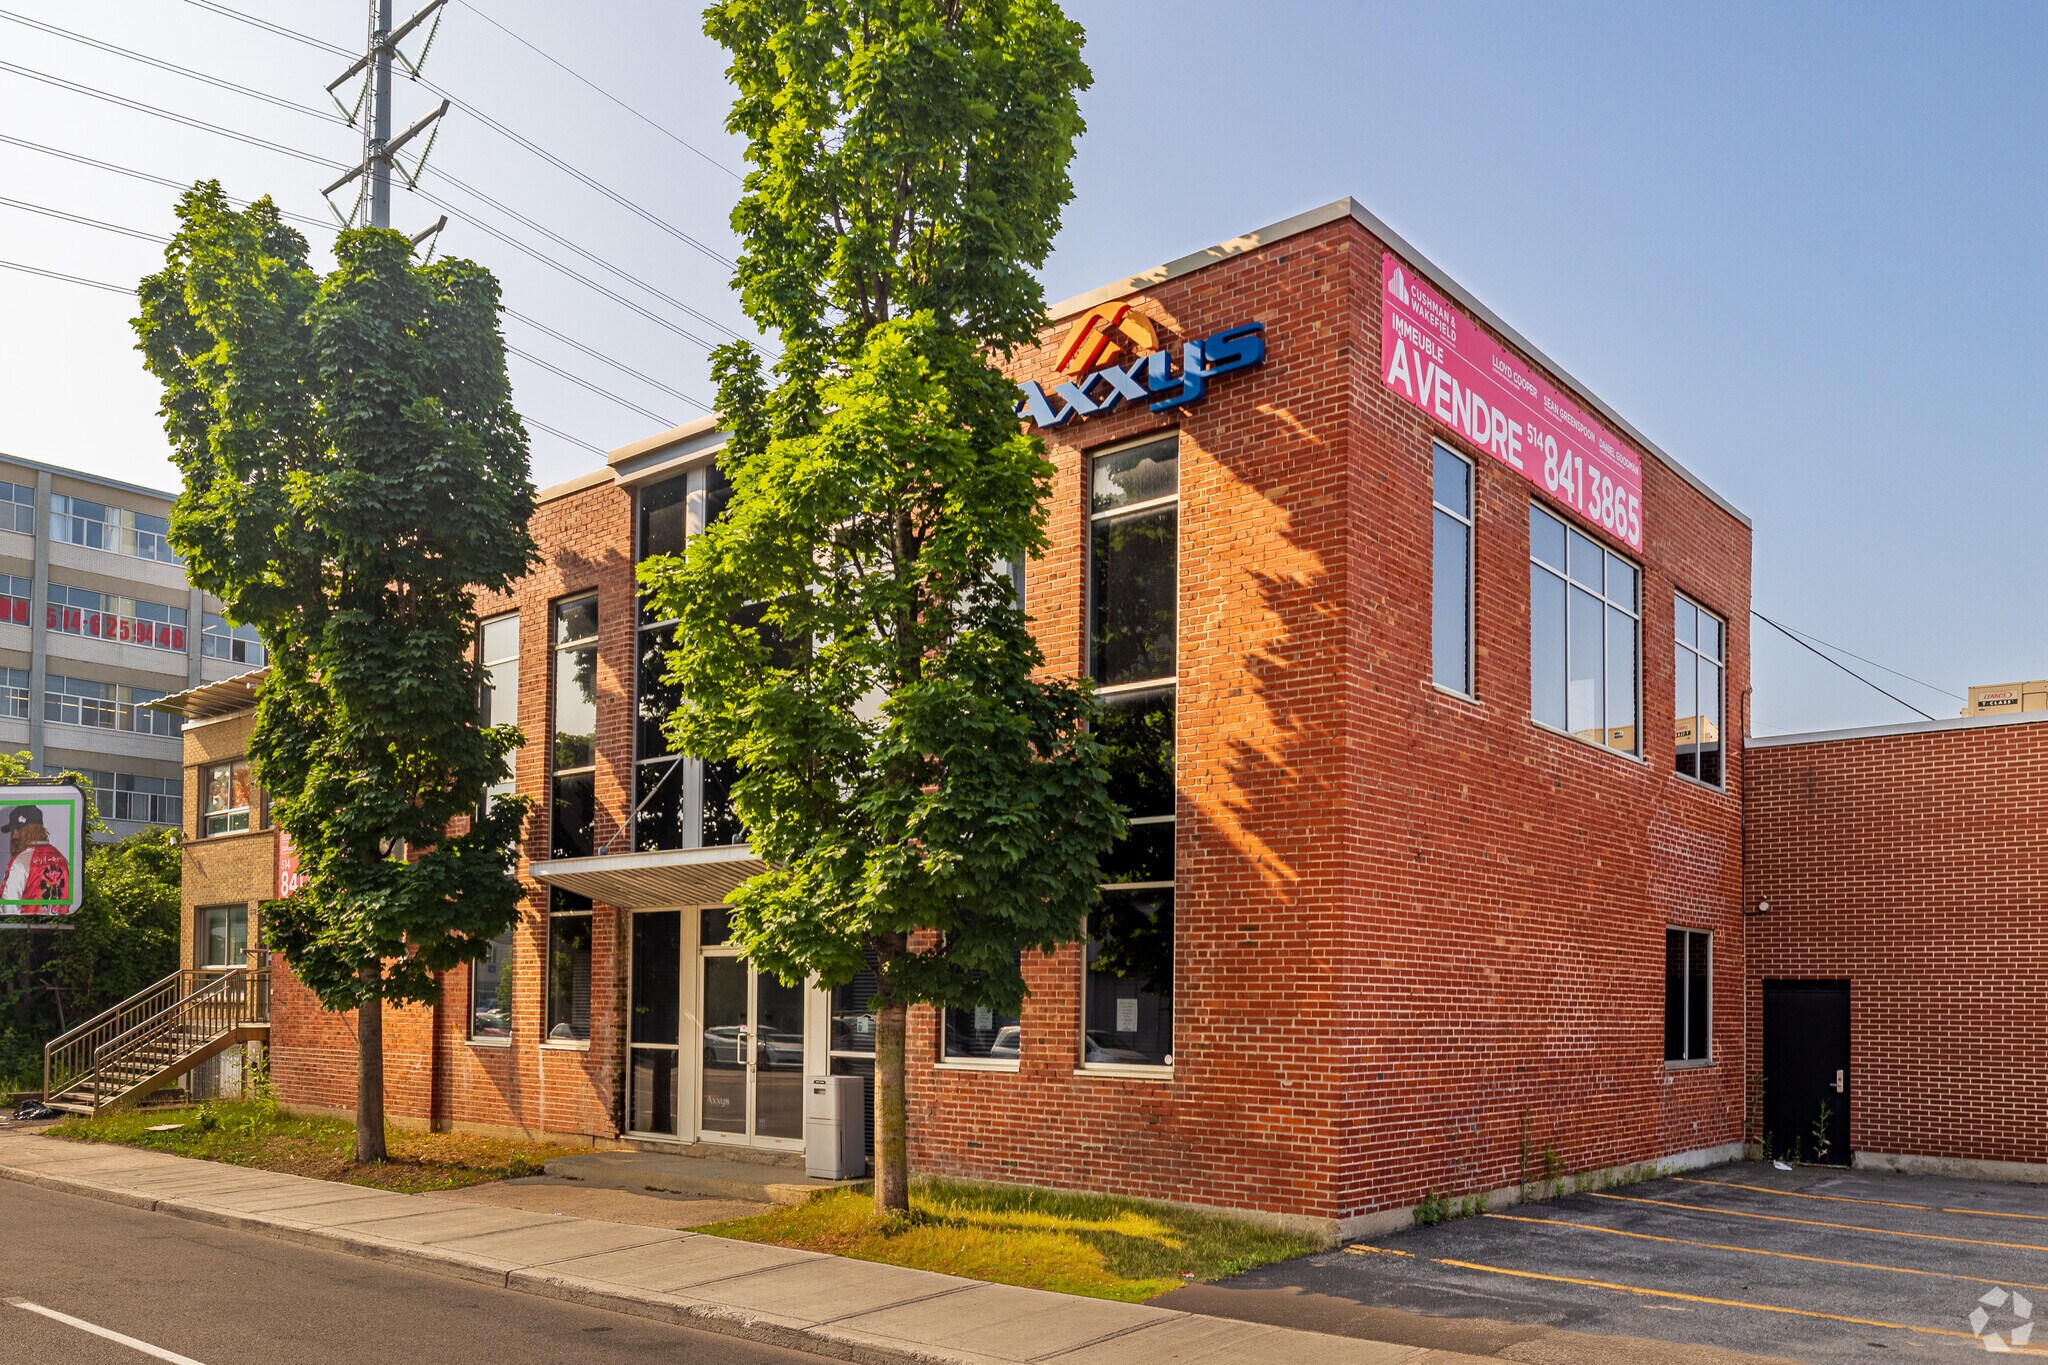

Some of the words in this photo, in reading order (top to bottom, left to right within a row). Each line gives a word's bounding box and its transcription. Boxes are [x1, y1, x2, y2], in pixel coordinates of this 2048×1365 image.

[1411, 285, 1450, 323] CUSHMAN
[1450, 316, 1457, 329] &
[1411, 298, 1457, 342] WAKEFIELD
[1391, 312, 1444, 365] IMMEUBLE
[1492, 354, 1512, 378] LLOYD
[1513, 372, 1538, 399] COOPER
[1543, 395, 1559, 415] SEAN
[1559, 408, 1596, 442] GREENSPOON
[1526, 422, 1544, 451] 514
[1544, 434, 1583, 510] 841
[1588, 464, 1640, 545] 3865
